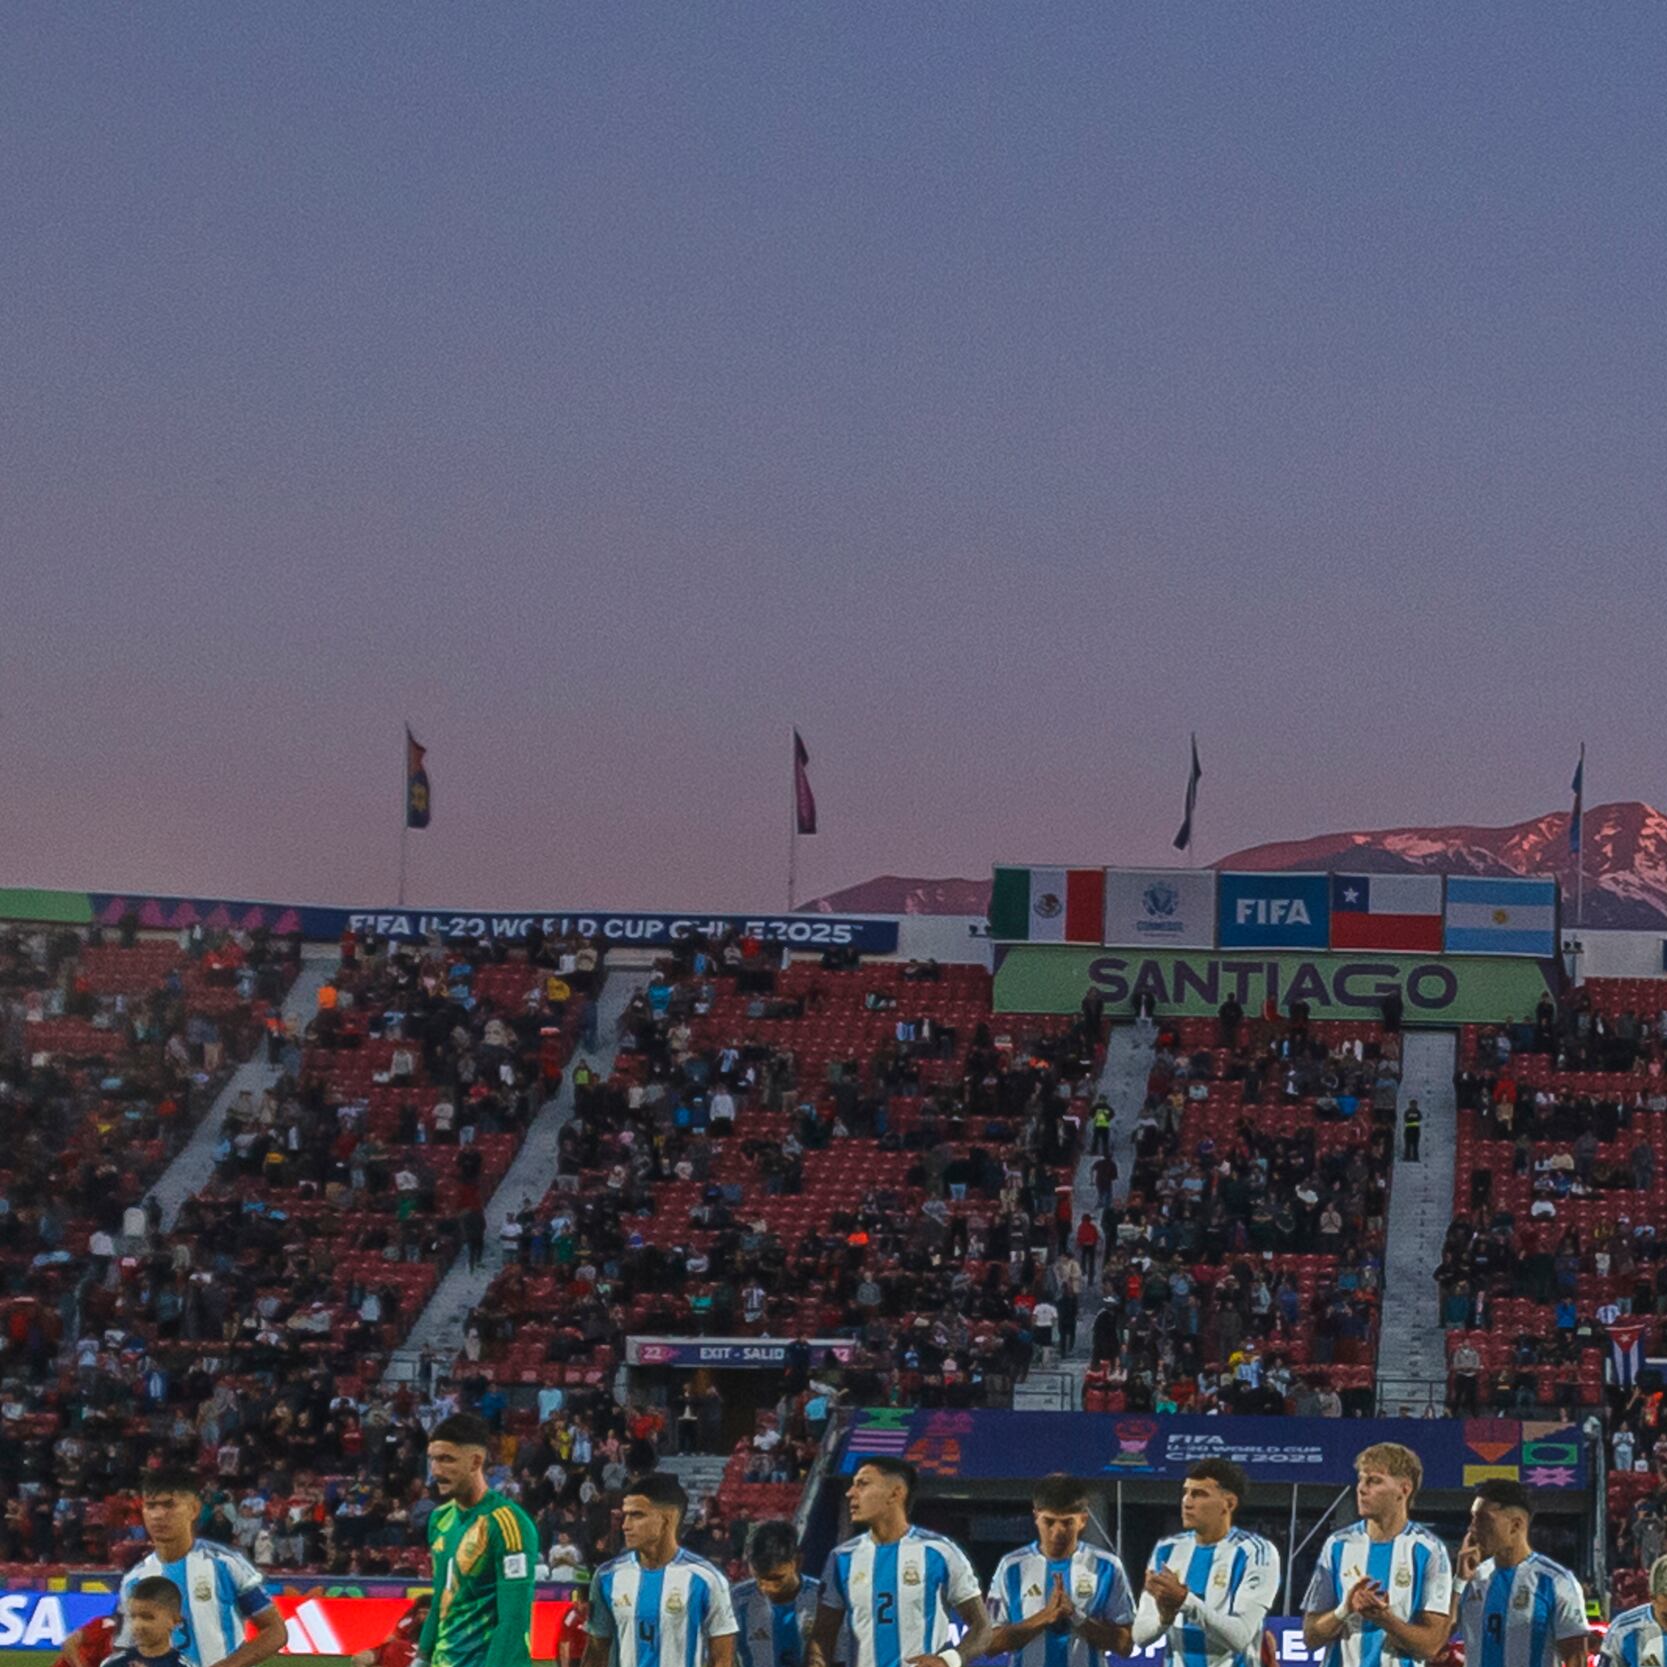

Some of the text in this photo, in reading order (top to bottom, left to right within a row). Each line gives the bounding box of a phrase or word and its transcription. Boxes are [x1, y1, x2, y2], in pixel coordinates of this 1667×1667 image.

[1236, 898, 1311, 926] FIFA
[603, 918, 664, 938] CUP
[668, 920, 765, 940] CHIE
[1088, 957, 1459, 1010] SANTIAGO
[643, 1347, 662, 1360] 22
[699, 1347, 730, 1360] EXIT
[743, 1347, 785, 1361] SALID
[1168, 1434, 1225, 1445] FIFA
[877, 1591, 894, 1624] 2
[639, 1620, 656, 1642] 4
[1487, 1613, 1501, 1646] 9
